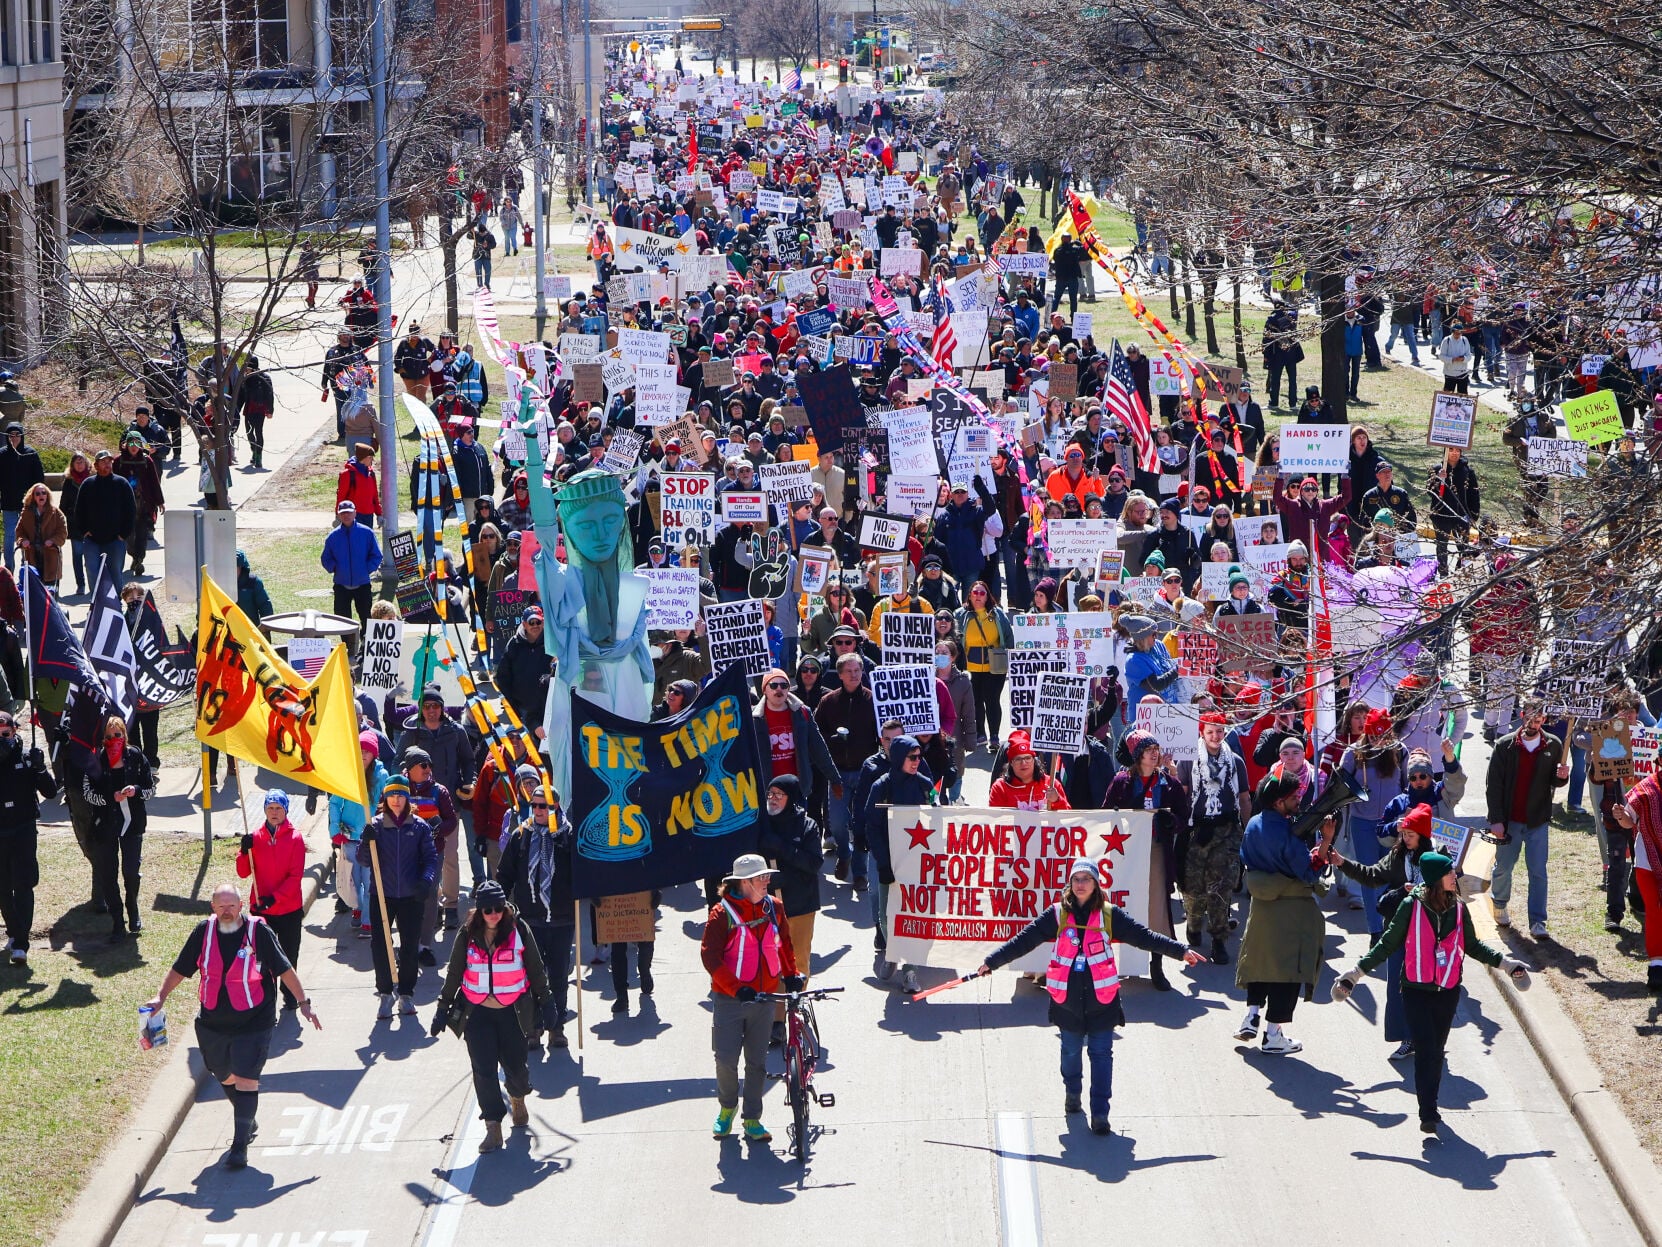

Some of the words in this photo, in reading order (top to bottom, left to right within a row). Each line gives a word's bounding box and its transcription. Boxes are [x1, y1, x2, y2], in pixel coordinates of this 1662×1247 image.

[645, 236, 660, 245] NO
[776, 229, 798, 240] FIGHT
[636, 243, 656, 257] FAUX
[657, 245, 675, 257] KING
[778, 242, 800, 253] OLI-
[646, 255, 663, 266] WAY
[811, 319, 831, 327] TAYLOR
[567, 337, 593, 347] KINGS
[817, 343, 828, 353] ICE!
[572, 346, 590, 356] FALL
[626, 347, 647, 357] SUCKS
[602, 362, 626, 382] KINGS
[640, 368, 659, 379] THIS
[663, 369, 673, 378] IS
[639, 384, 659, 392] WHAT
[642, 392, 674, 402] DEMOCRACY
[1438, 396, 1449, 404] Stop
[902, 405, 926, 416] POWER
[1568, 408, 1582, 420] NO
[1583, 402, 1609, 416] KINGS
[868, 412, 880, 425] MAY
[898, 420, 921, 430] PEOPLE
[1435, 420, 1453, 428] STOP
[1574, 422, 1588, 432] JUST
[1589, 419, 1601, 429] DRAG
[677, 430, 691, 440] DAY
[895, 425, 930, 436] STRONGER
[1286, 429, 1319, 438] HANDS
[1323, 429, 1344, 437] OFF
[613, 435, 628, 449] MAY
[627, 439, 640, 451] DAY
[890, 435, 911, 446] THAN
[914, 432, 927, 440] THE
[902, 437, 927, 448] PEOPLE
[1528, 438, 1586, 452] AUTHORITY
[1307, 443, 1322, 452] MY
[761, 465, 777, 478] RON
[777, 461, 811, 476] JOHNSON
[894, 453, 934, 473] POWER
[1283, 458, 1345, 467] DEMOCRACY
[664, 478, 709, 495] STOP
[772, 476, 804, 487] PROTECTS
[900, 486, 926, 494] American
[662, 495, 713, 511] TRADING
[911, 500, 933, 509] tyrant
[662, 510, 712, 528] BLOOD
[874, 518, 888, 532] NO
[390, 534, 412, 548] HANDS
[684, 527, 712, 546] OIL
[871, 534, 896, 549] KING
[1072, 538, 1097, 546] CONCEIT
[393, 542, 415, 559] OFF!
[770, 535, 778, 557] WAR
[1050, 546, 1067, 555] NOT
[658, 572, 671, 580] WAR
[803, 575, 820, 585] NOPE
[678, 586, 696, 595] SAFETY
[881, 581, 899, 590] NOPE
[496, 591, 524, 605] TOO
[671, 598, 690, 607] FAMILY
[707, 604, 746, 617] MAY
[749, 602, 761, 611] 1:
[496, 618, 508, 627] TO
[707, 613, 745, 631] STAND
[746, 611, 763, 625] UP
[884, 615, 902, 633] NO
[904, 615, 933, 635] NEW
[1016, 613, 1068, 628] UNFIT
[1217, 620, 1236, 634] NO
[1239, 620, 1272, 632] ICE
[373, 622, 396, 640] NO
[709, 629, 724, 642] TO
[725, 624, 764, 640] TRUMP
[1057, 627, 1111, 641] RAPIST
[136, 628, 159, 660] NO
[884, 633, 902, 648] US
[903, 635, 934, 649] WAR
[1182, 634, 1214, 648] KILL
[365, 641, 401, 658] KINGS
[711, 637, 767, 660] GENERAL
[885, 651, 901, 663] IN
[903, 652, 933, 664] THE
[1010, 652, 1049, 661] MAY
[1054, 652, 1066, 661] 1:
[372, 659, 391, 674] NO
[1010, 662, 1050, 675] STAND
[1051, 662, 1067, 672] UP
[362, 672, 399, 690] TYRANTS
[873, 670, 887, 682] NO
[889, 669, 913, 681] WAR
[914, 667, 928, 678] ON
[1011, 675, 1025, 687] TO
[1043, 674, 1087, 690] FIGHT
[874, 679, 932, 702] CUBA!
[1040, 684, 1068, 700] RACISM,
[1069, 687, 1086, 701] WAR
[198, 681, 230, 726] IS
[877, 702, 905, 717] END
[906, 701, 933, 715] THE
[1038, 698, 1051, 709] AND
[1050, 699, 1084, 713] POVERTY:
[1137, 705, 1151, 719] NO
[1155, 704, 1176, 719] ICE
[1037, 713, 1055, 727] "THE
[1055, 715, 1061, 728] 3
[1061, 716, 1083, 730] EVILS
[582, 726, 650, 773] THE
[659, 698, 739, 768] TIME
[1035, 727, 1046, 741] OF
[1046, 728, 1081, 744] SOCIETY"
[1137, 721, 1151, 733] NO
[1154, 720, 1184, 742] Kings
[1598, 760, 1608, 768] TO
[1613, 759, 1632, 767] MELT
[1600, 769, 1613, 777] THE
[1617, 768, 1630, 776] ICE
[608, 804, 642, 846] IS
[666, 768, 758, 836] NOW
[1441, 822, 1465, 840] ICE!
[947, 822, 1036, 858] MONEY
[1040, 825, 1088, 858] FOR
[920, 853, 1032, 890] PEOPLE'S
[900, 883, 943, 914] NOT
[947, 885, 984, 917] THE
[990, 887, 1039, 918] WAR
[598, 910, 611, 920] NO
[613, 908, 650, 919] DICTATORS
[902, 919, 928, 936] PARTY
[931, 920, 945, 937] FOR
[945, 921, 988, 939] SOCIALISM
[992, 923, 1012, 939] AND
[260, 1103, 411, 1157] BIKE
